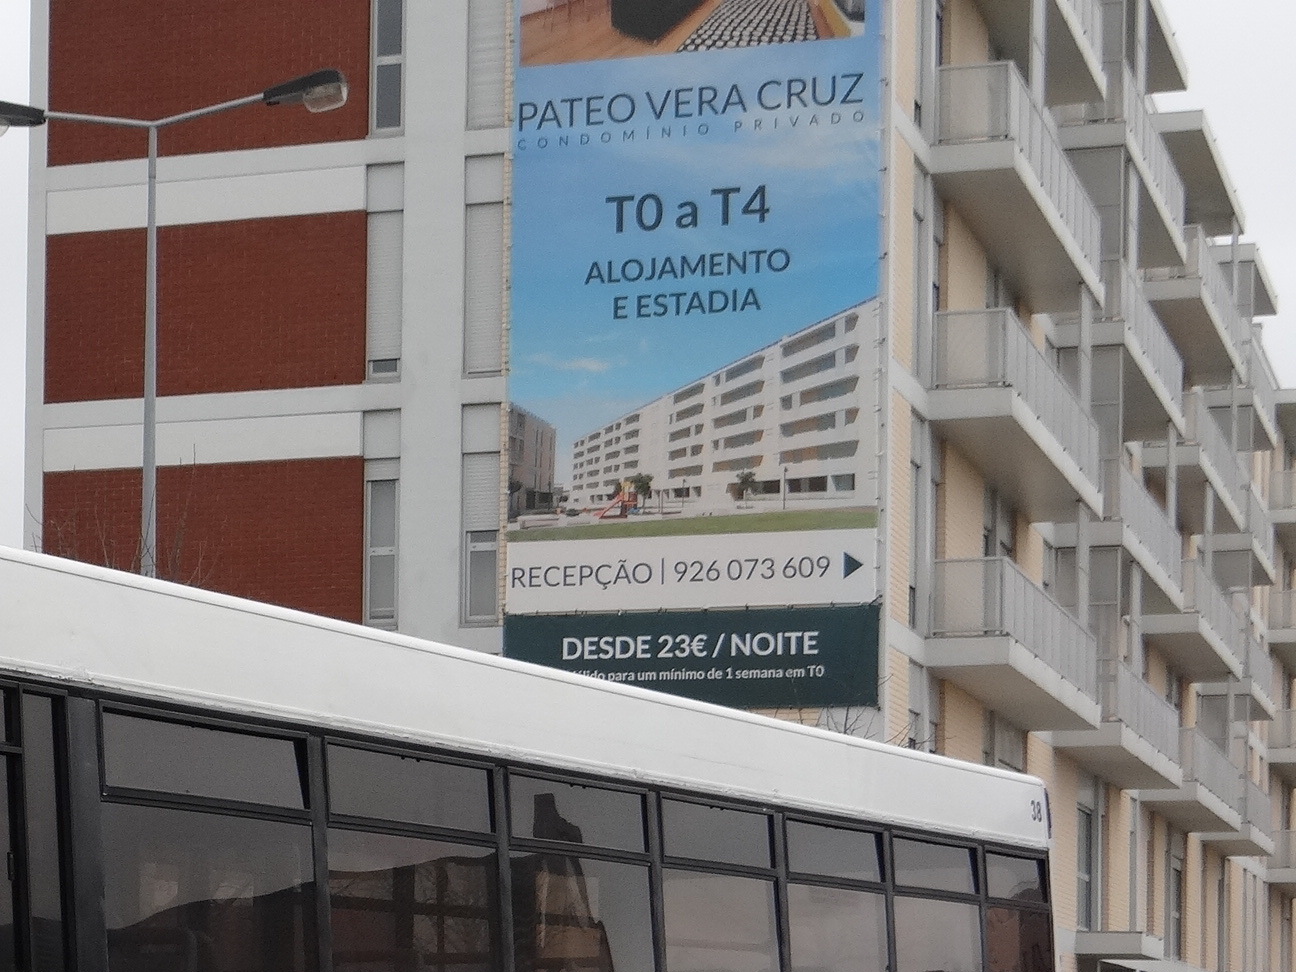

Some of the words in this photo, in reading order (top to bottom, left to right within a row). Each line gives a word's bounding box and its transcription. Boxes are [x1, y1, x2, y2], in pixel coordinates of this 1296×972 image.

[517, 93, 636, 132] PATEO
[645, 84, 748, 121] VERA
[757, 72, 865, 112] CRUZ
[734, 110, 865, 134] PRIVADO
[605, 192, 664, 234] T0
[675, 199, 699, 230] a
[711, 184, 771, 226] T4
[584, 248, 791, 286] ALOJAMENTO
[612, 296, 628, 320] E
[636, 288, 762, 318] ESTADIA
[510, 558, 653, 590] RECEPÇÃO
[673, 560, 720, 583] 926
[726, 558, 775, 581] 073
[782, 555, 831, 579] 609
[562, 635, 652, 661] DESDE
[657, 632, 708, 659] 23€
[731, 630, 819, 657] NOITE
[607, 671, 635, 683] para
[637, 671, 656, 681] um
[659, 667, 704, 681] mínimo
[707, 667, 722, 680] de
[725, 668, 733, 679] 1
[735, 669, 782, 680] semana
[785, 669, 804, 679] em
[1030, 800, 1042, 822] 38
